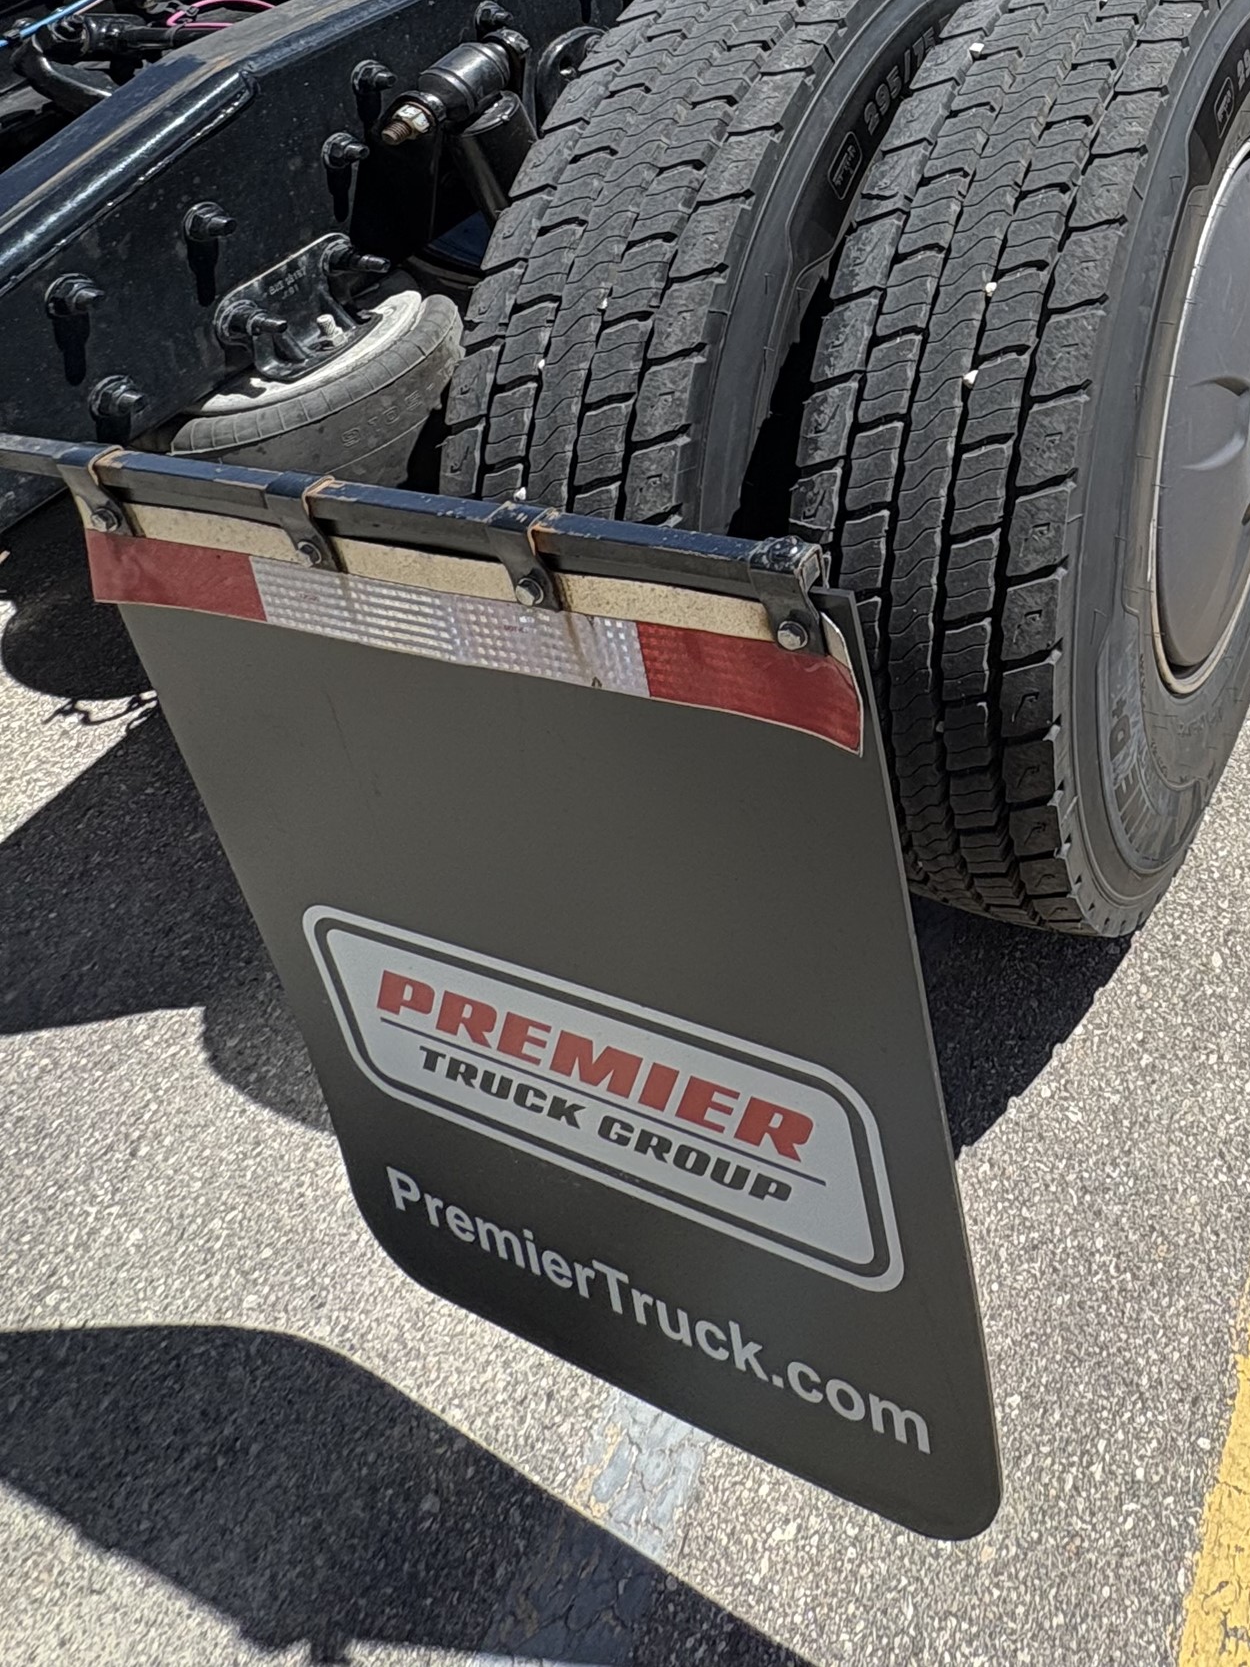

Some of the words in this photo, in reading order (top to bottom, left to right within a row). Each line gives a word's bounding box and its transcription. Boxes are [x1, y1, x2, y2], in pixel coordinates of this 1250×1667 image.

[376, 969, 814, 1163] PREMIER
[419, 1045, 587, 1129] TRUCK
[598, 1115, 792, 1202] GROUP
[386, 1166, 932, 1454] PremierTruck.com
